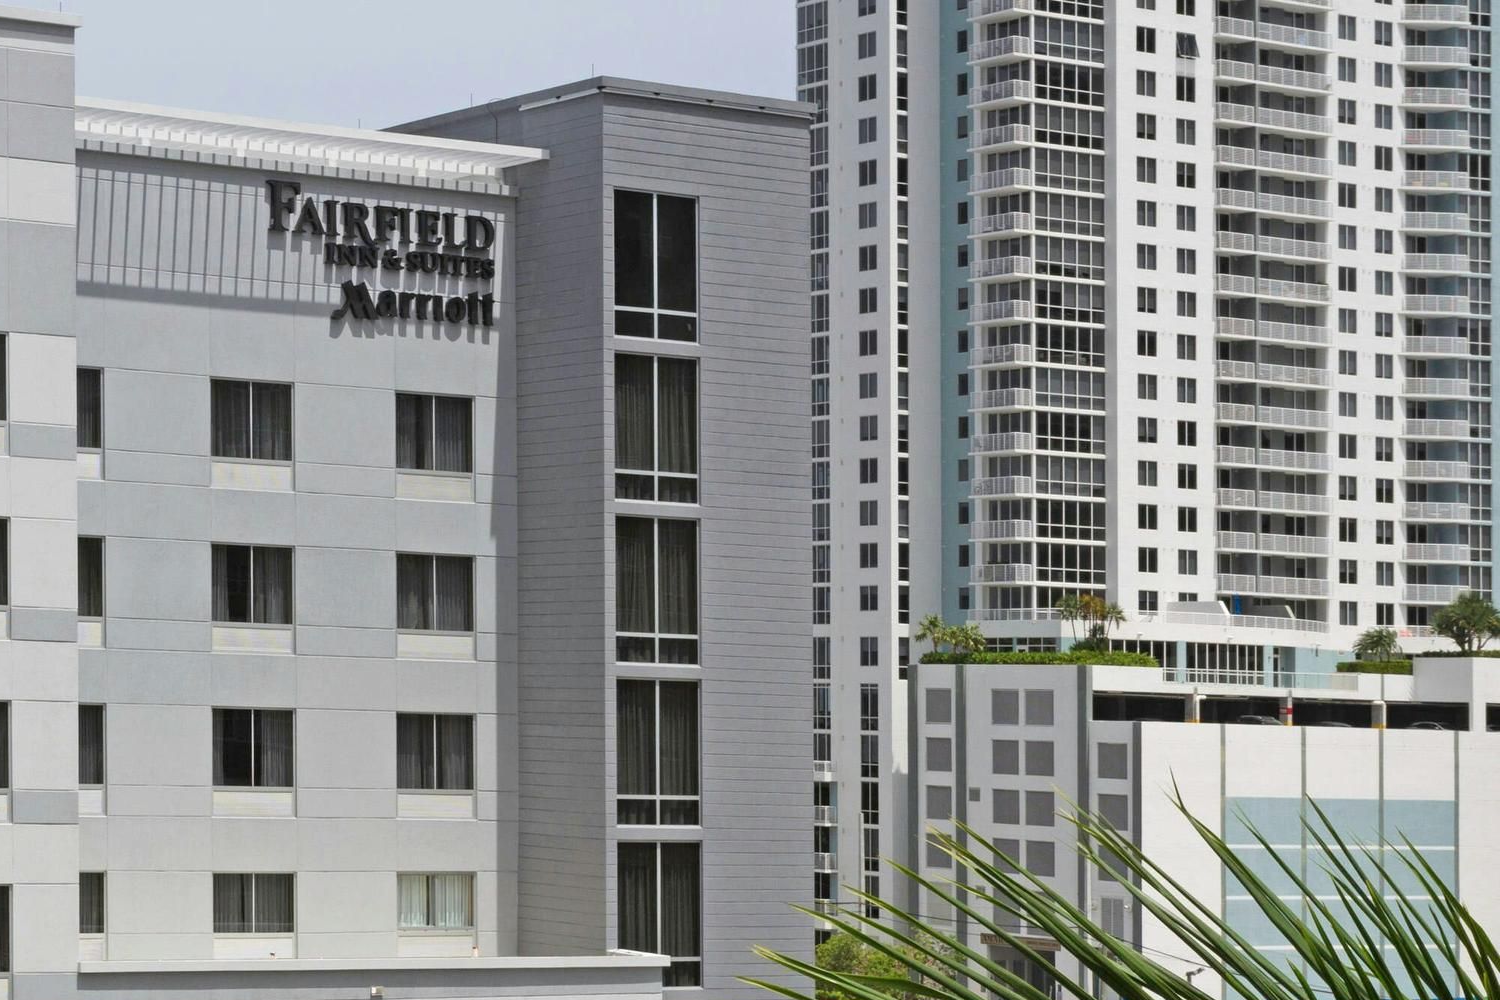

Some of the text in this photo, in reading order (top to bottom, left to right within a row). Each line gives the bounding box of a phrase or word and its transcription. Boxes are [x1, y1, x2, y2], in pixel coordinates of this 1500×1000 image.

[265, 179, 495, 251] FAIRFIELD
[324, 242, 496, 280] INN & SUITES
[330, 279, 494, 326] Marriott
